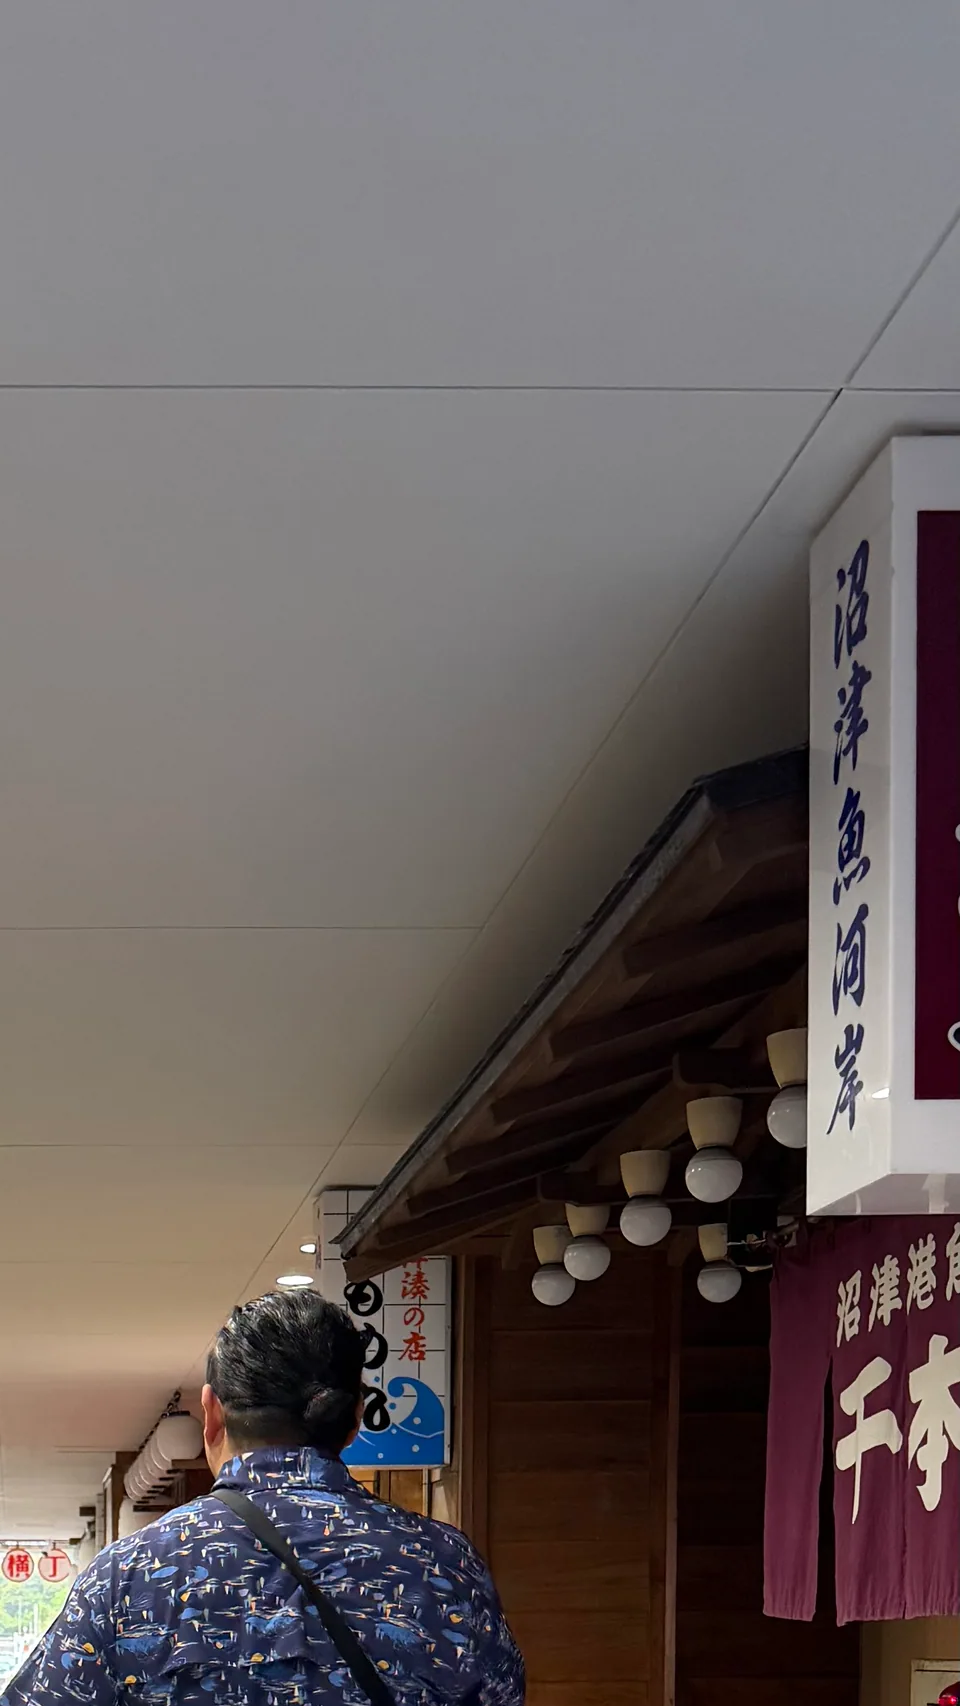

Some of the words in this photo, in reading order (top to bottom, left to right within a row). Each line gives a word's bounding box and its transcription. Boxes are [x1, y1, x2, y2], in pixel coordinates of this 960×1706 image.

[826, 539, 872, 1137] 沼津魚河岸
[836, 1334, 960, 1525] 千本
